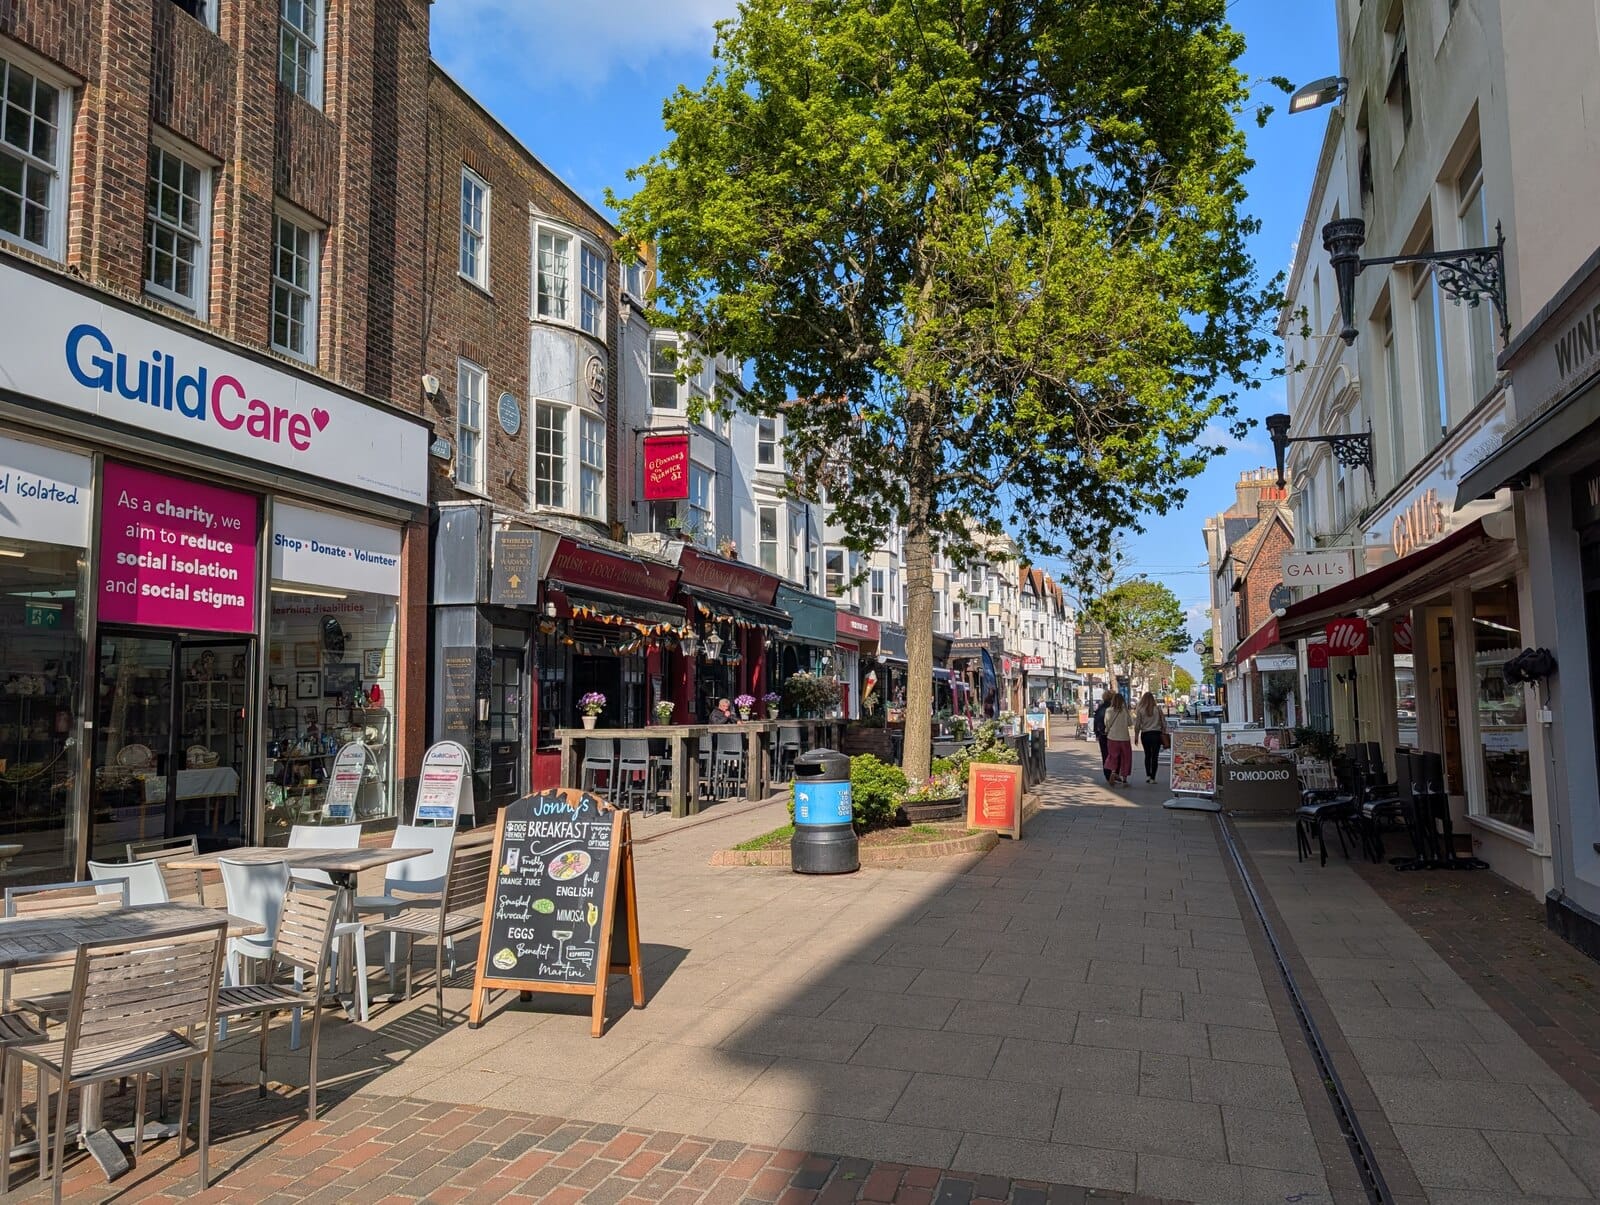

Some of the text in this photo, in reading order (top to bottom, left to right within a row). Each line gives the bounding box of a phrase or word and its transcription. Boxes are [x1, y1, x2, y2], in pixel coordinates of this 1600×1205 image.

[65, 323, 312, 451] GuildCare
[17, 475, 79, 504] isolated.
[118, 490, 241, 530] As a charity, we
[126, 522, 233, 554] aim to reduce
[274, 533, 397, 567] Shop Donate Volunteer
[117, 551, 238, 580] social isolation
[105, 578, 245, 609] and social stigma
[313, 602, 365, 614] disabilities
[1329, 624, 1365, 651] illy
[1229, 769, 1290, 782] POMODORO
[534, 797, 589, 821] Jonny's
[513, 823, 526, 832] DOG
[528, 820, 589, 839] BREAKFAST
[500, 877, 541, 886] ORANGE JUICE
[556, 886, 594, 898] ENGLISH
[496, 907, 532, 922] Avocado
[556, 909, 585, 922] MIMOSA
[508, 927, 535, 940] EGGS
